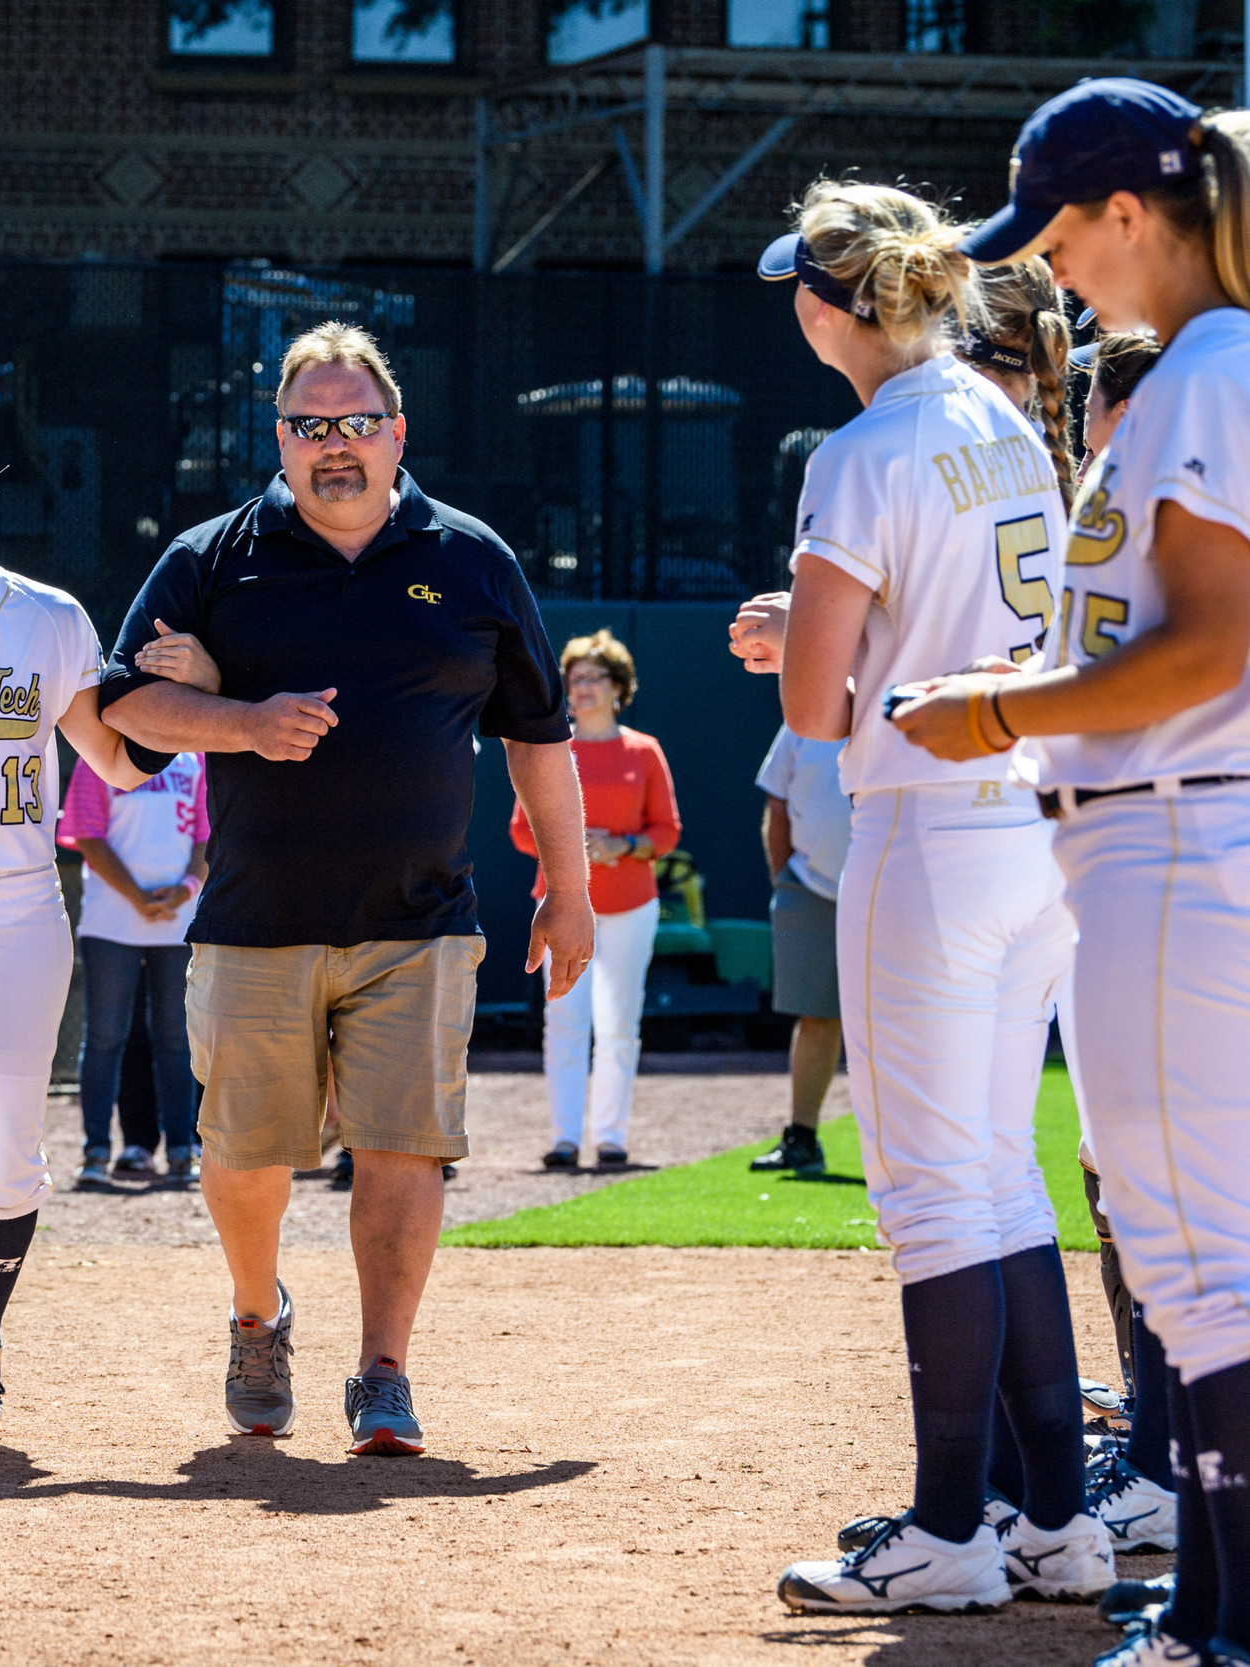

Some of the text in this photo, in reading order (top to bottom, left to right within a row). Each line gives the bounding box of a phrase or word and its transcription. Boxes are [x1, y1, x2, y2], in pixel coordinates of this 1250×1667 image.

[931, 434, 1060, 515] BARFIEL
[407, 584, 442, 605] GT
[0, 755, 44, 826] 13
